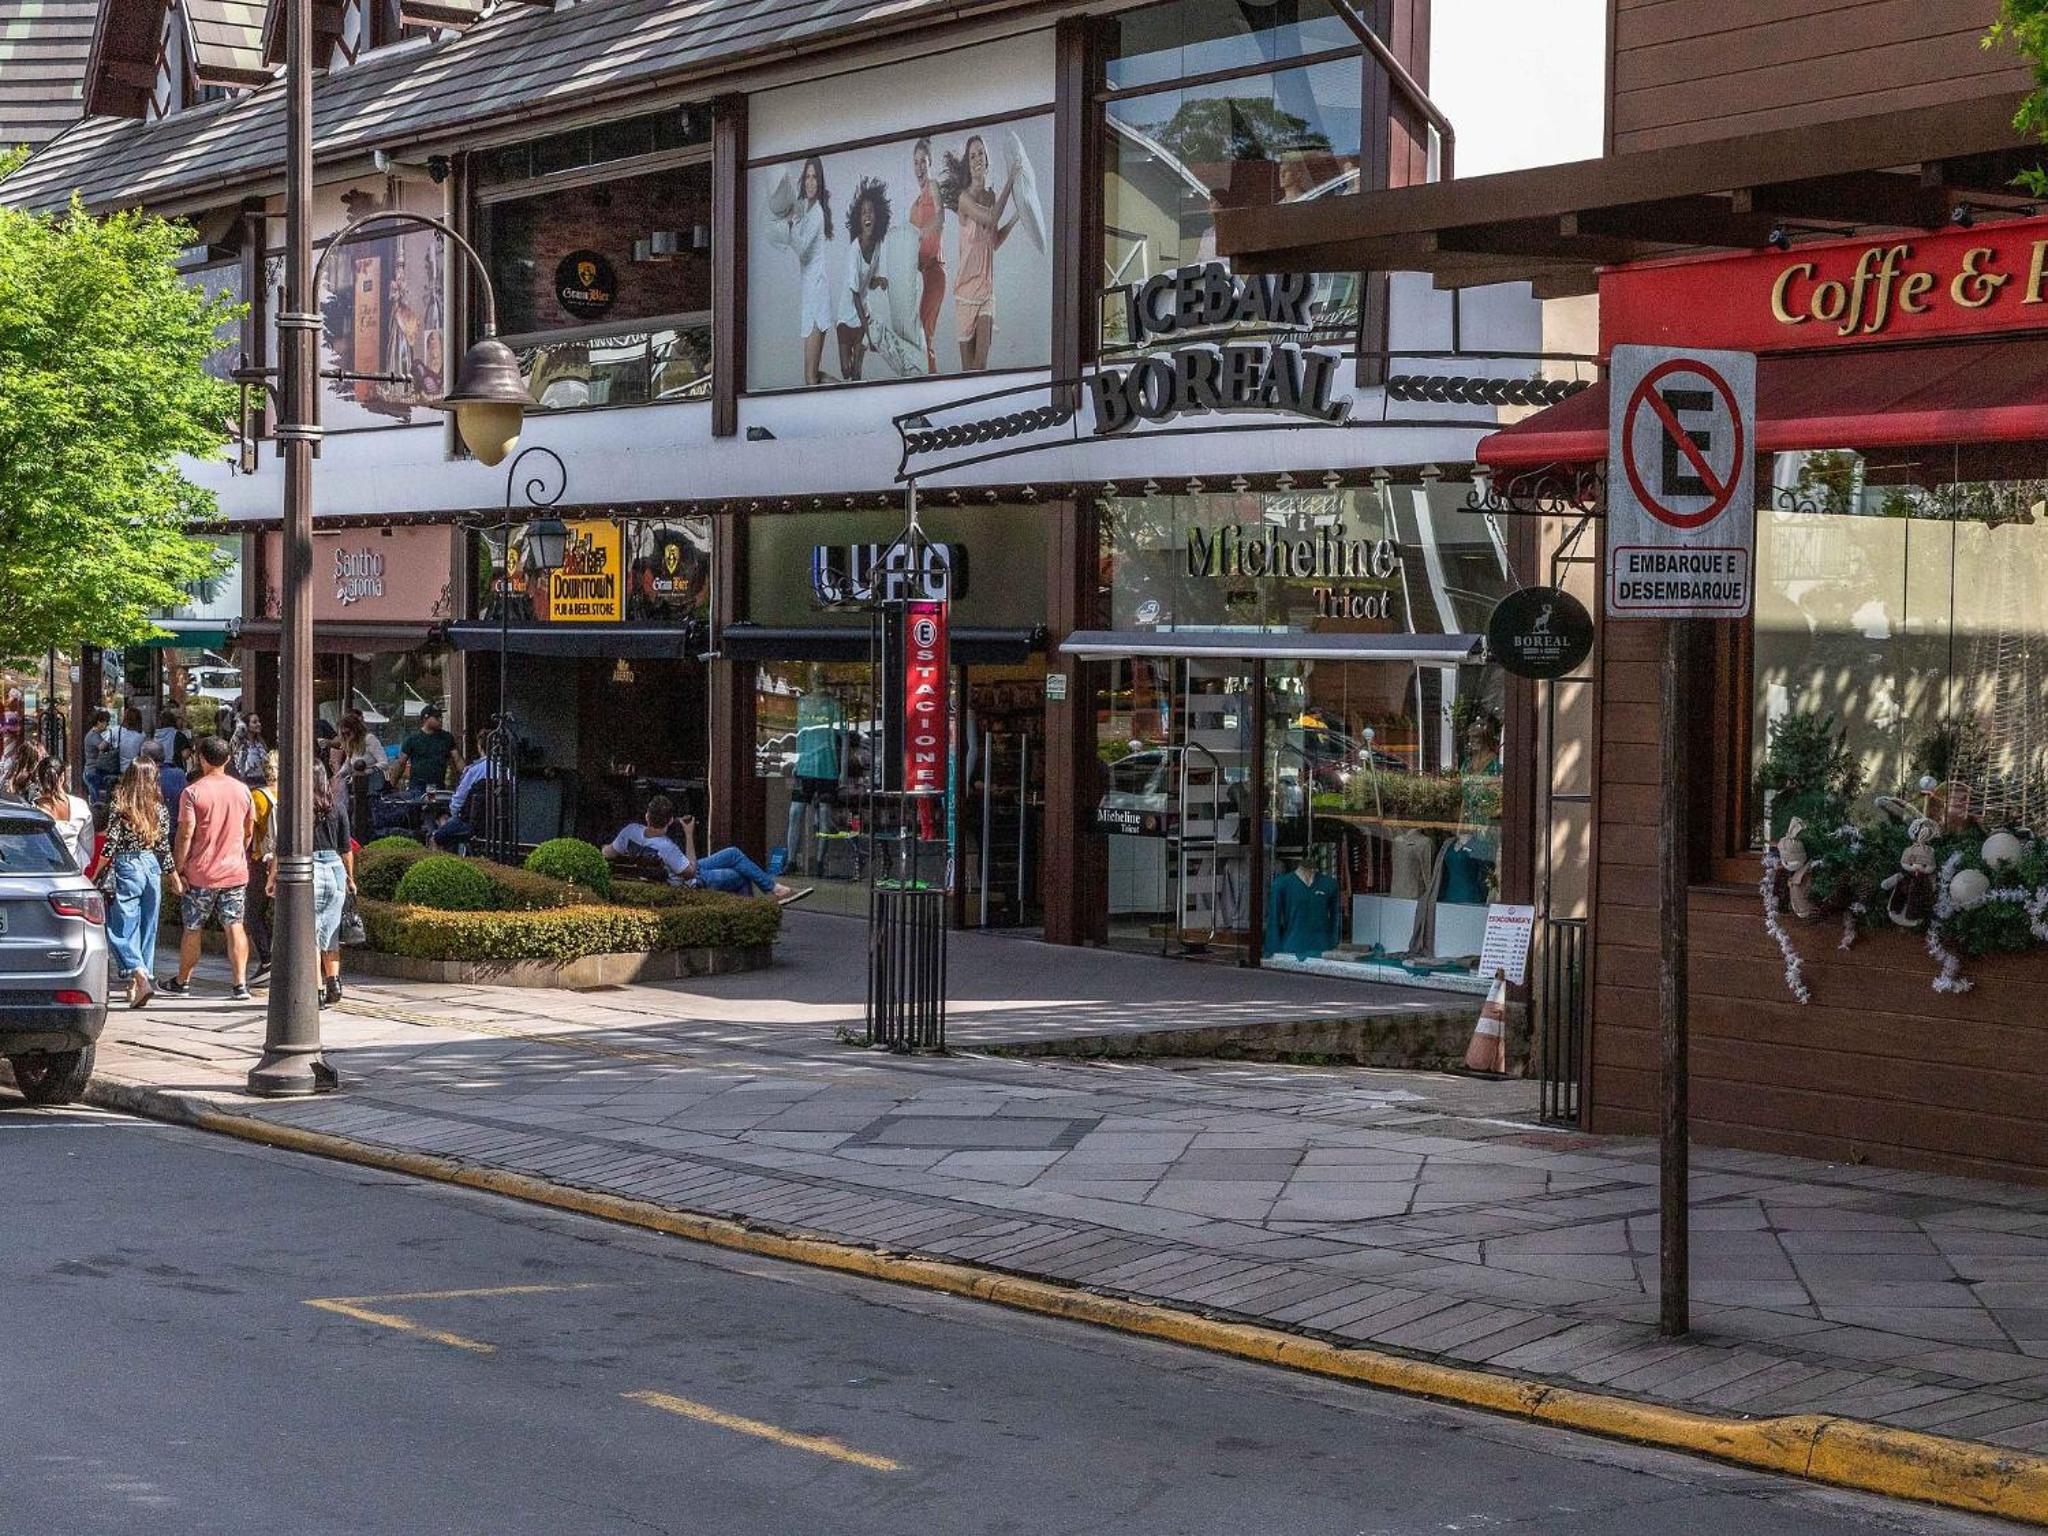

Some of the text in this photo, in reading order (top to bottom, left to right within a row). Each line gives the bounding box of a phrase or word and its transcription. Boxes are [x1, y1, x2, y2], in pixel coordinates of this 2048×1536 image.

[1771, 245, 1934, 336] Coffe
[1950, 247, 2009, 308] &
[1089, 341, 1354, 434] BOREAL
[335, 547, 382, 577] Santho
[1184, 524, 1400, 579] Micheline
[1629, 554, 1736, 573] EMBARQUE E
[1312, 586, 1391, 619] Tricot
[1619, 581, 1742, 600] DESEMBARQUE
[554, 603, 568, 615] PUB
[592, 603, 614, 615] STORE
[1514, 636, 1571, 646] BOREAL
[914, 619, 937, 780] ESTACIONE
[1097, 808, 1141, 824] Micheline
